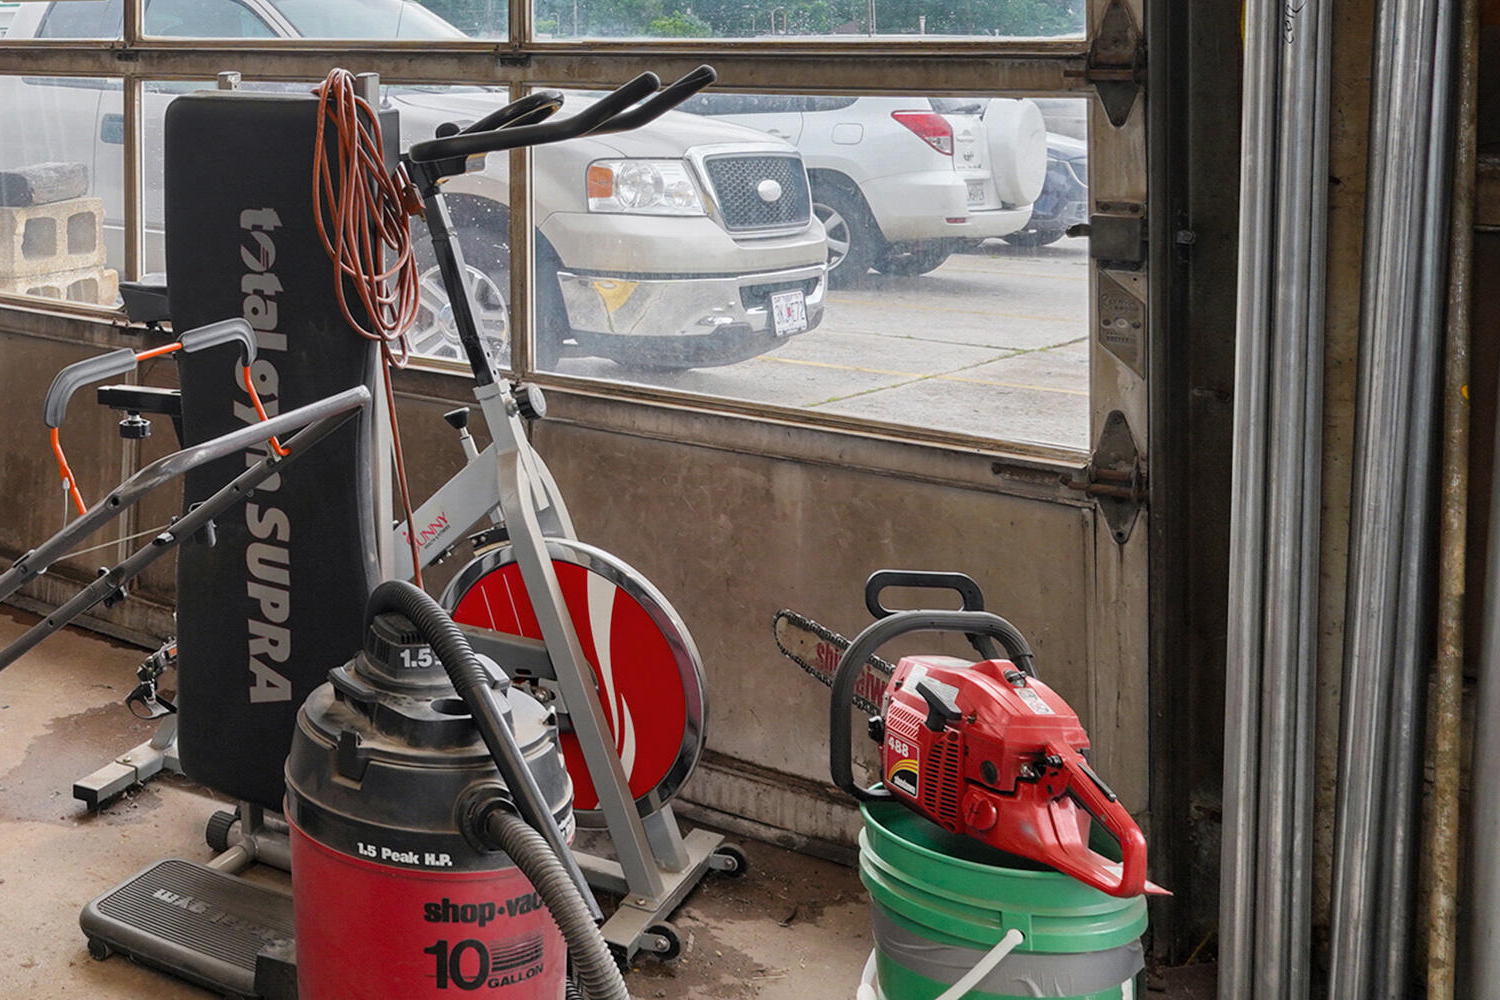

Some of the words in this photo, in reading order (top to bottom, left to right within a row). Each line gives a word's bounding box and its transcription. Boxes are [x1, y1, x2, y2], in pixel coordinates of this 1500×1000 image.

[245, 502, 292, 704] SUPRA
[400, 647, 433, 668] 1.5
[888, 735, 910, 758] 488
[356, 842, 377, 858] 1.5
[380, 847, 420, 865] Peak
[424, 854, 453, 867] H.P.
[423, 939, 490, 991] 10
[487, 963, 544, 989] GALLON
